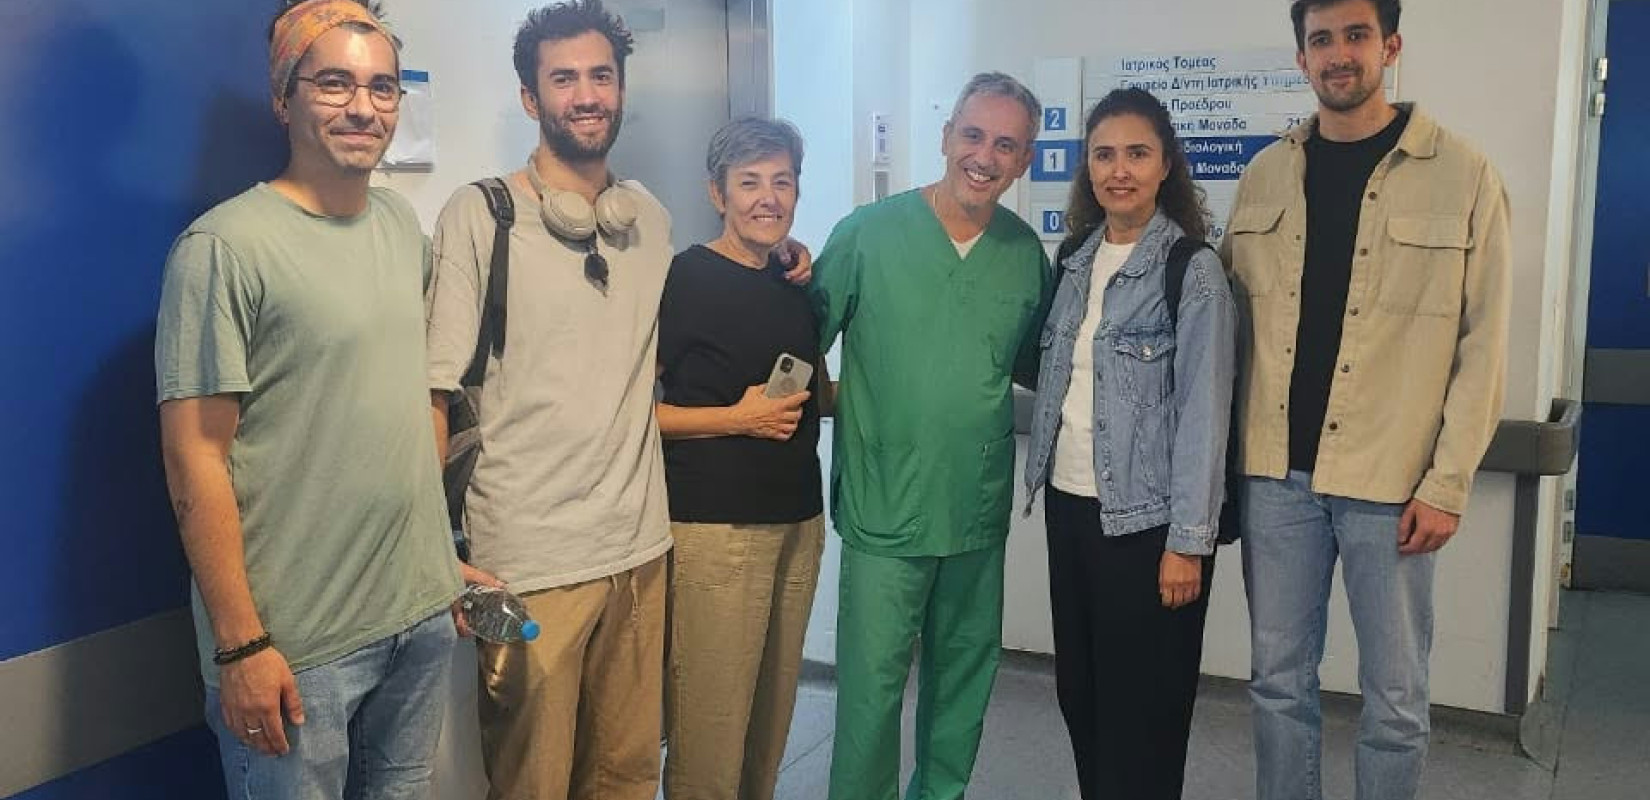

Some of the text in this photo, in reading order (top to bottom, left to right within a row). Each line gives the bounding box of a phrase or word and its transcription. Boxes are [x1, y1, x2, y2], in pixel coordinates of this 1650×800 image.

[1121, 56, 1216, 72] Ιατρικός Τομέας
[1207, 75, 1257, 90] Ιατρικής
[1171, 97, 1232, 113] Προέδρου
[1049, 109, 1060, 128] 2
[1049, 152, 1057, 170] 1
[1049, 212, 1060, 231] 0
